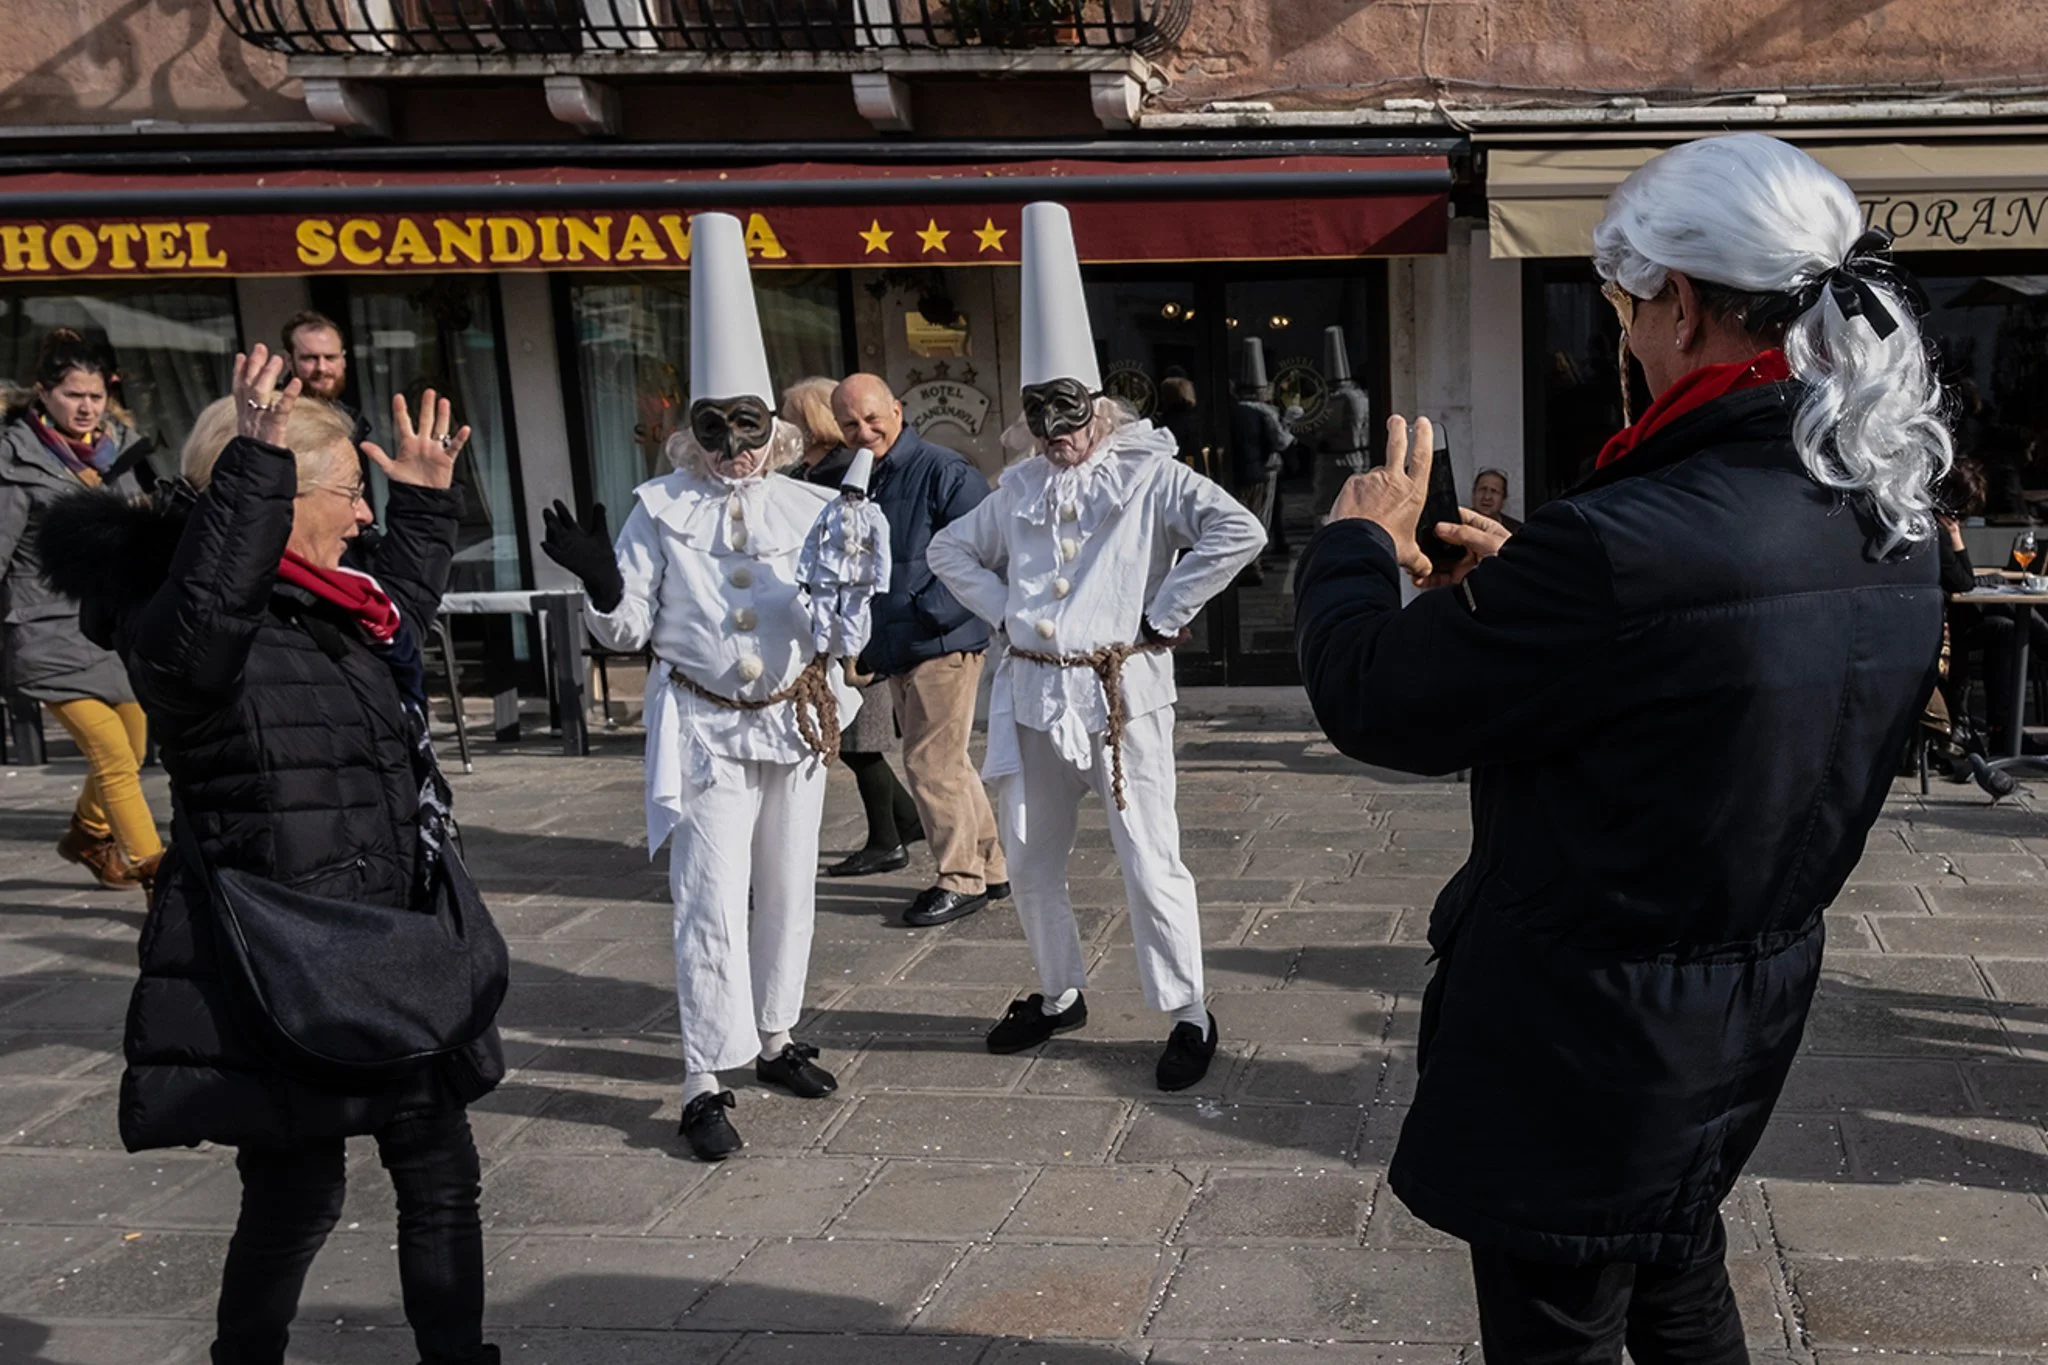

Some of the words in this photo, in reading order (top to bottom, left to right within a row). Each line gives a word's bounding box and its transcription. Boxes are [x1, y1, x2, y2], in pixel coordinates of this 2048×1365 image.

[0, 222, 228, 271] HOTEL
[296, 213, 787, 265] SCANDINAVA
[920, 385, 964, 400] HOTEL
